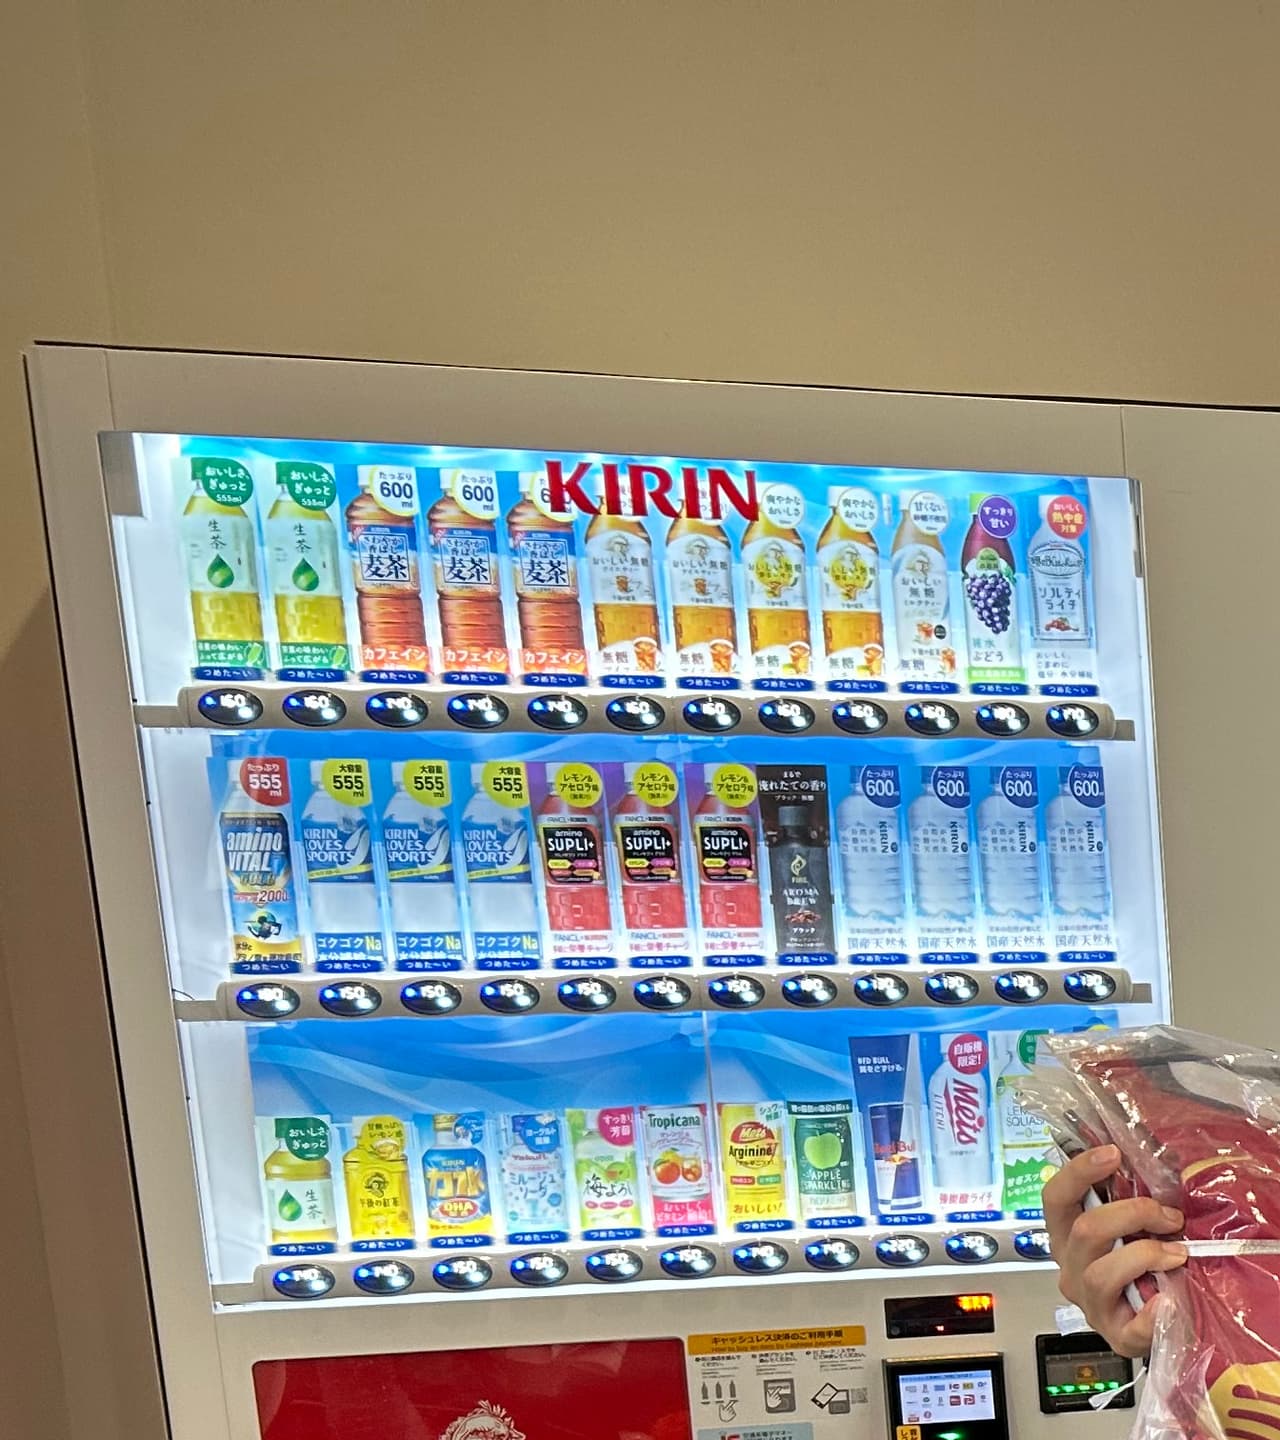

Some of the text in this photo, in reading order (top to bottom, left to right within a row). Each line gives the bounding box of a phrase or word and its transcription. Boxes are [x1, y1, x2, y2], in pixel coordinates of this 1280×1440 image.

[380, 482, 413, 498] 600
[462, 485, 494, 501] 600
[546, 460, 760, 522] KIRIN
[367, 555, 407, 578] 麦茶
[449, 558, 488, 582] 麦茶
[527, 560, 567, 583] 麦茶
[364, 648, 426, 661] カフェイン
[446, 650, 506, 663] カフェイン
[525, 651, 584, 663] カフェイン
[339, 765, 362, 773] 大容量
[420, 766, 442, 774] 大容量
[499, 766, 522, 775] 大容量
[249, 774, 282, 789] 555
[333, 775, 364, 790] 555
[414, 777, 444, 791] 555
[492, 777, 522, 792] 555
[866, 779, 894, 797] 600
[937, 780, 964, 797] 600
[1005, 780, 1032, 797] 600
[1074, 780, 1099, 797] 600
[226, 827, 283, 851] amino
[304, 828, 338, 839] KIRIN
[385, 828, 419, 839] KIRIN
[463, 829, 497, 840] KIRIN
[879, 821, 889, 854] KIRIN
[950, 822, 959, 854] KIRIN
[1018, 822, 1026, 853] KIRIN
[1086, 821, 1096, 852] KIRIN
[307, 852, 355, 863] SPORTS
[388, 852, 436, 863] SPORTS
[467, 851, 513, 863] SPORTS
[649, 1113, 700, 1130] Tropicana
[729, 1145, 772, 1158] Arginine
[712, 1330, 843, 1345] キャッシュレス決済のご利用手順
